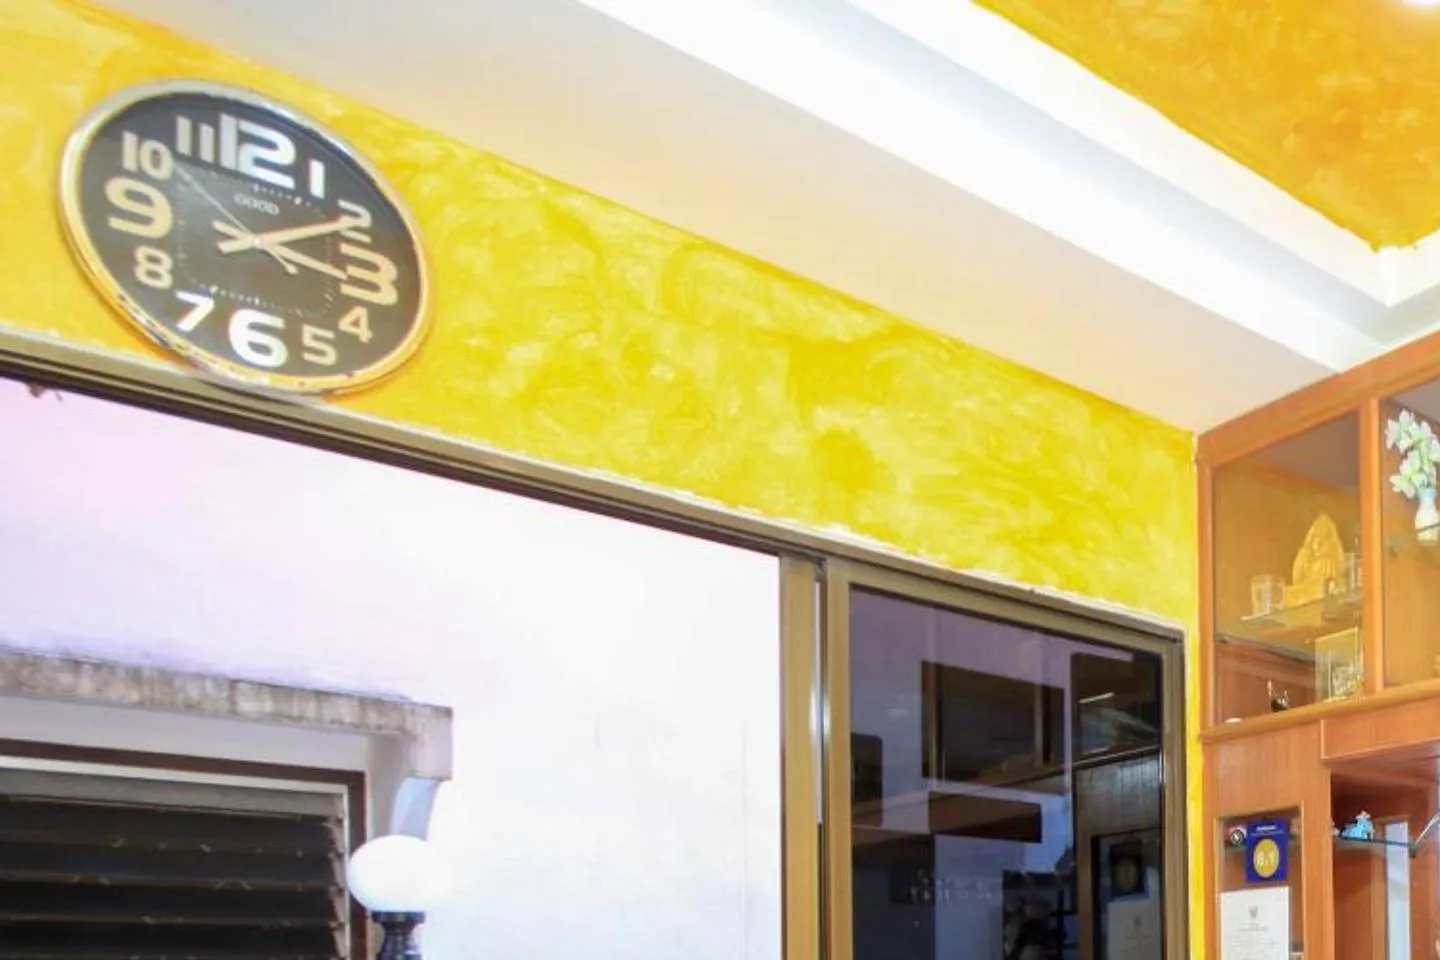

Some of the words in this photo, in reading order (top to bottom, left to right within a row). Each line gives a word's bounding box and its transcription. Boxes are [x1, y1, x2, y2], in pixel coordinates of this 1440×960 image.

[122, 130, 175, 180] 10
[219, 113, 296, 189] 12
[309, 158, 325, 199] 1
[105, 177, 173, 239] 9
[338, 199, 372, 243] 2
[133, 245, 173, 289] 8
[339, 243, 398, 305] 3
[176, 290, 215, 332] 7
[338, 306, 372, 343] 4
[228, 308, 287, 368] 6
[302, 324, 337, 366] 5
